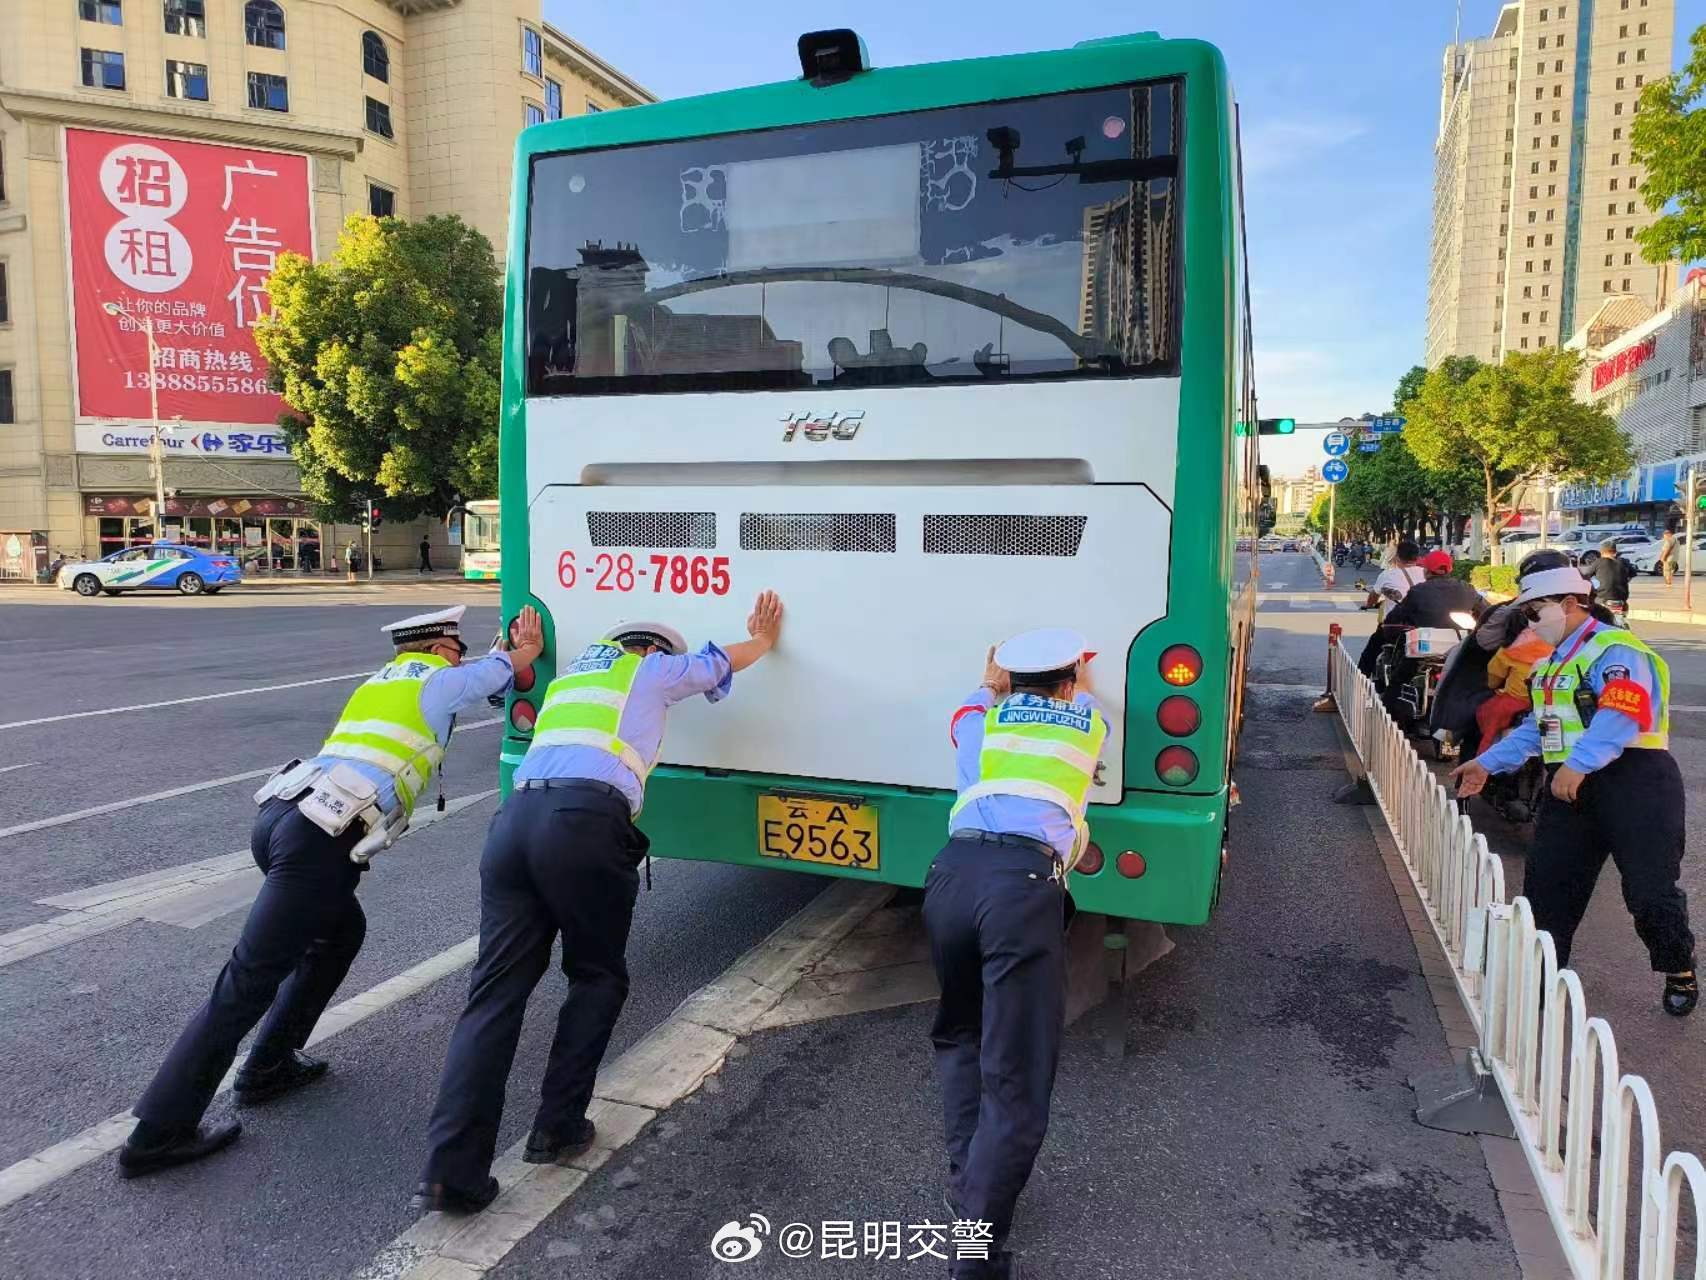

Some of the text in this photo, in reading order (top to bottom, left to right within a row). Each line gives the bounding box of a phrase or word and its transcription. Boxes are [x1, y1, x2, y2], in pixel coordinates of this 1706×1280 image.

[116, 156, 177, 277] 招租
[221, 159, 282, 329] 广告位
[117, 296, 207, 318] 让你的品牌
[153, 347, 254, 373] 招商热线
[228, 433, 293, 454] 家乐
[1003, 710, 1087, 730] JINGWUFUZHU
[764, 819, 872, 863] E9563
